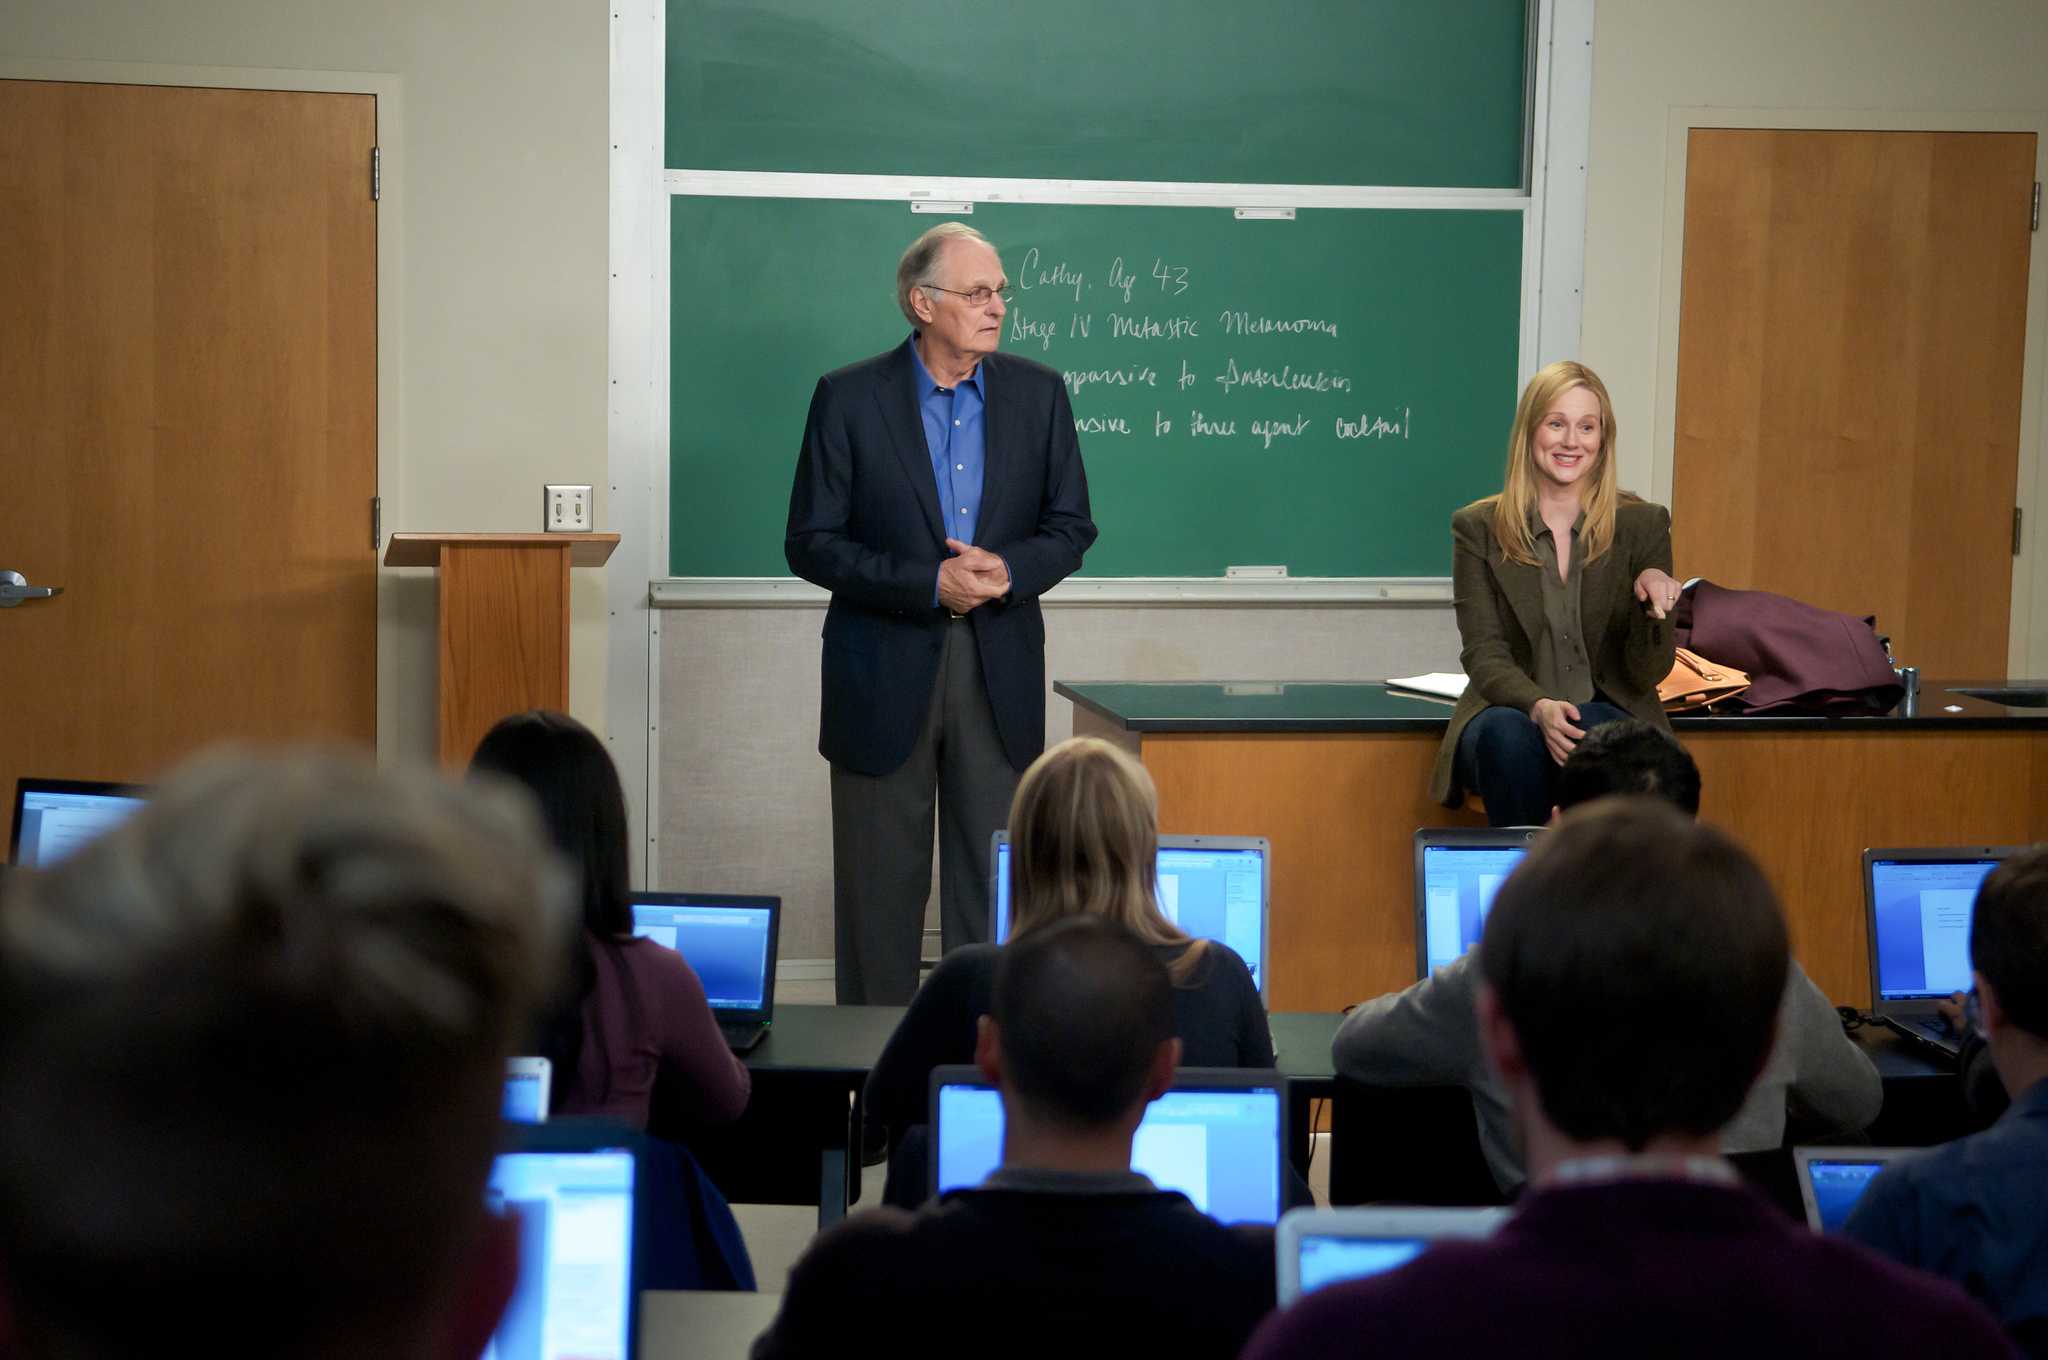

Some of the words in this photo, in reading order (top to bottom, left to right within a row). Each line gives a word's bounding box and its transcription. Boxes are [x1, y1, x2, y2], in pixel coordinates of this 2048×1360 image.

[1108, 256, 1136, 303] Age
[1152, 257, 1189, 296] 43
[1010, 306, 1056, 351] Stage
[1070, 312, 1091, 339] IV
[1219, 310, 1337, 338] Melanoma
[1178, 359, 1196, 391] to
[1155, 410, 1171, 437] to
[1190, 410, 1237, 437] three
[1251, 413, 1311, 449] agent
[1335, 406, 1410, 439] cocktail
